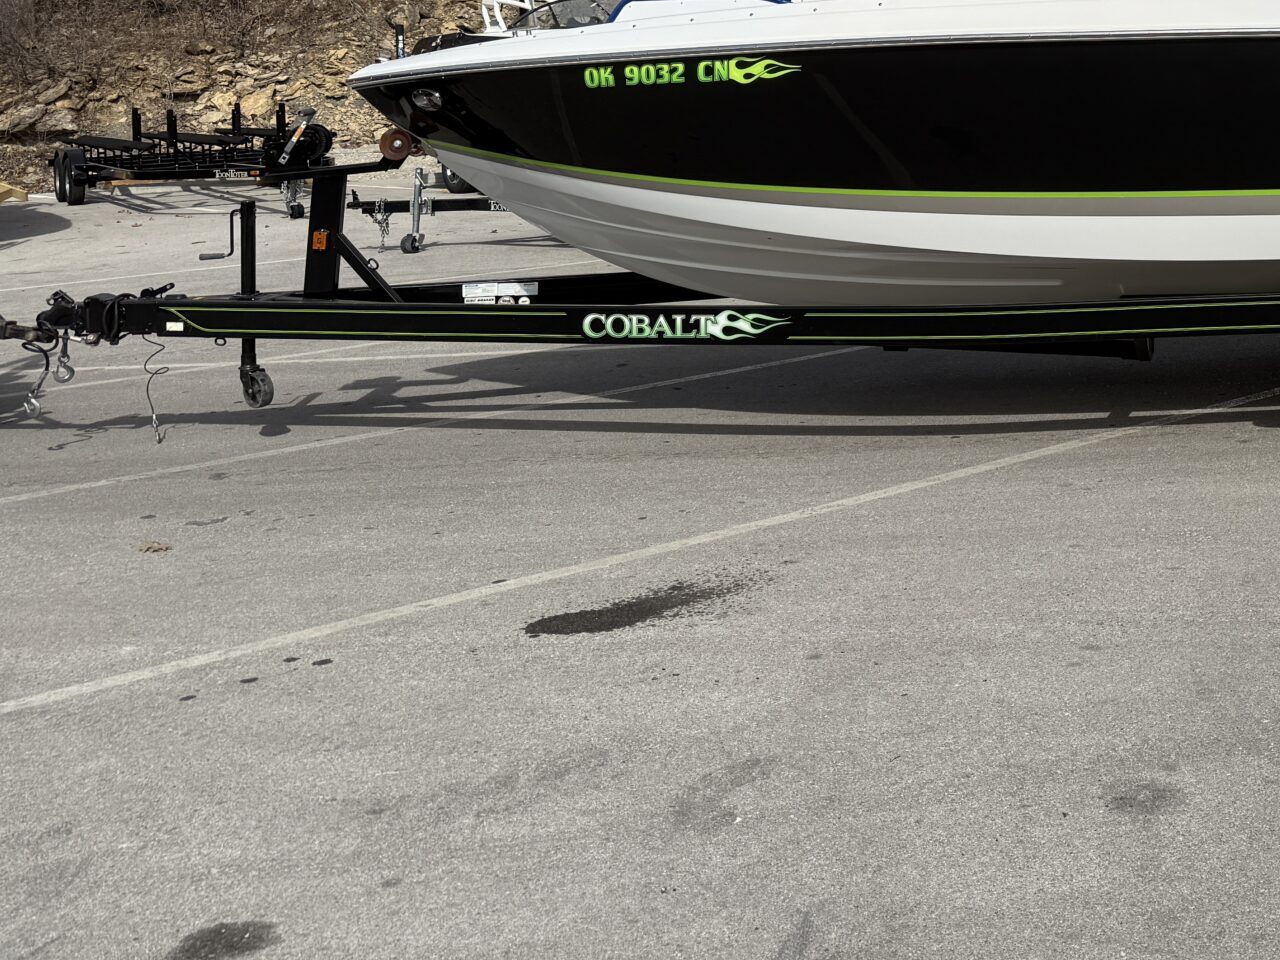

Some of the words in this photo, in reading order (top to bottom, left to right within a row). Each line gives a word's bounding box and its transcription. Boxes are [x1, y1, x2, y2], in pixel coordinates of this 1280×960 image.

[584, 66, 615, 88] OK
[624, 62, 685, 86] 9032
[697, 59, 730, 82] CN
[582, 313, 716, 338] COBALT
